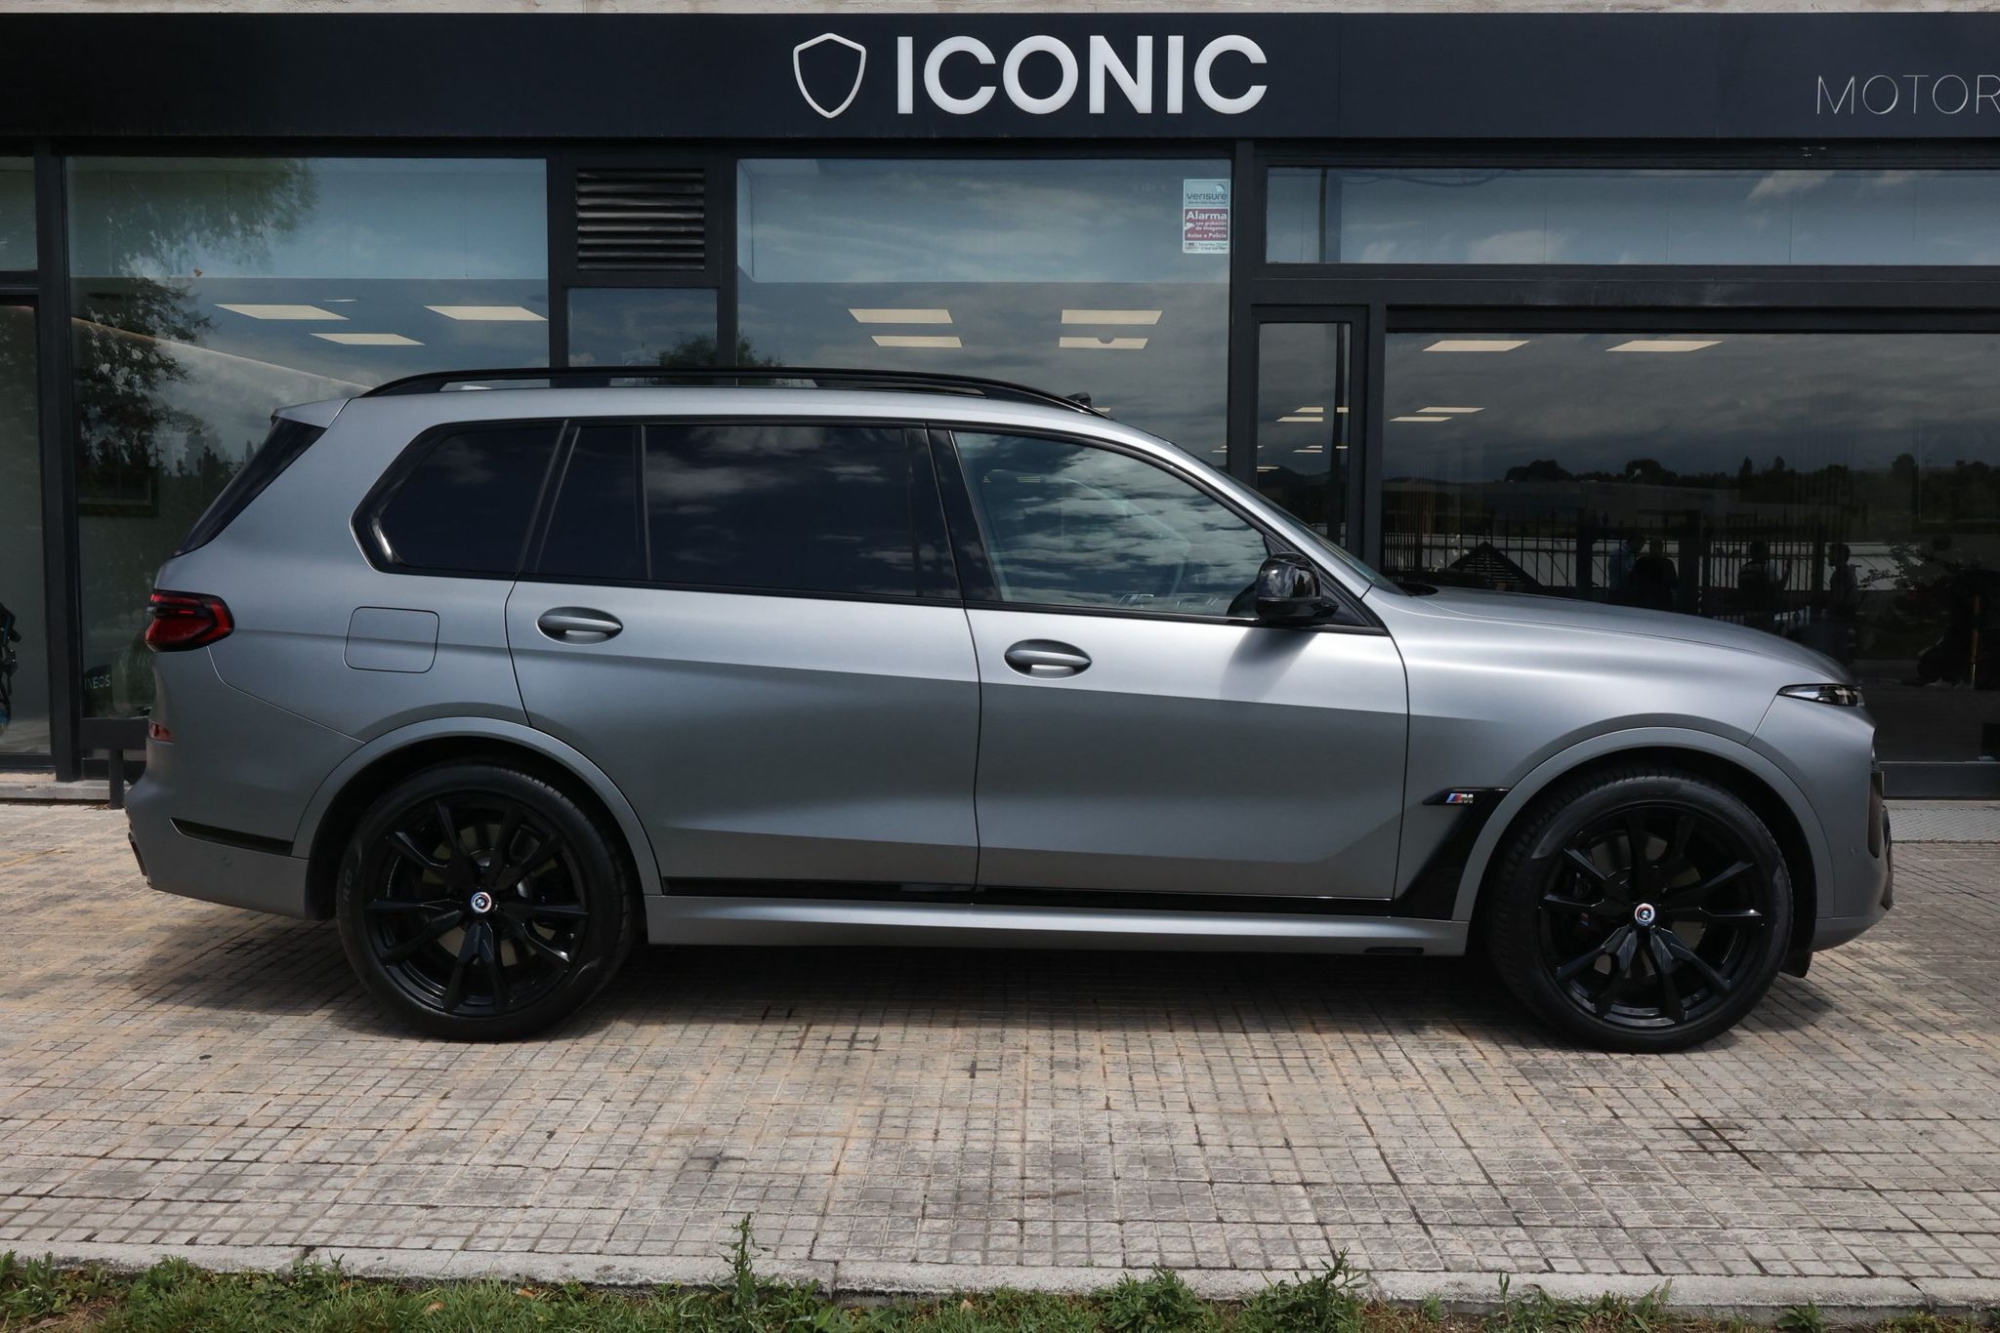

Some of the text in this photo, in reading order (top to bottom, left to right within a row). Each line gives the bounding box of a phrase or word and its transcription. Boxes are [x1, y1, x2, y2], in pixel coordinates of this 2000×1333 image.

[897, 34, 1267, 115] ICONIC
[1816, 74, 2000, 115] MOTOR
[1186, 192, 1227, 201] verisure
[1186, 210, 1227, 220] Alarma
